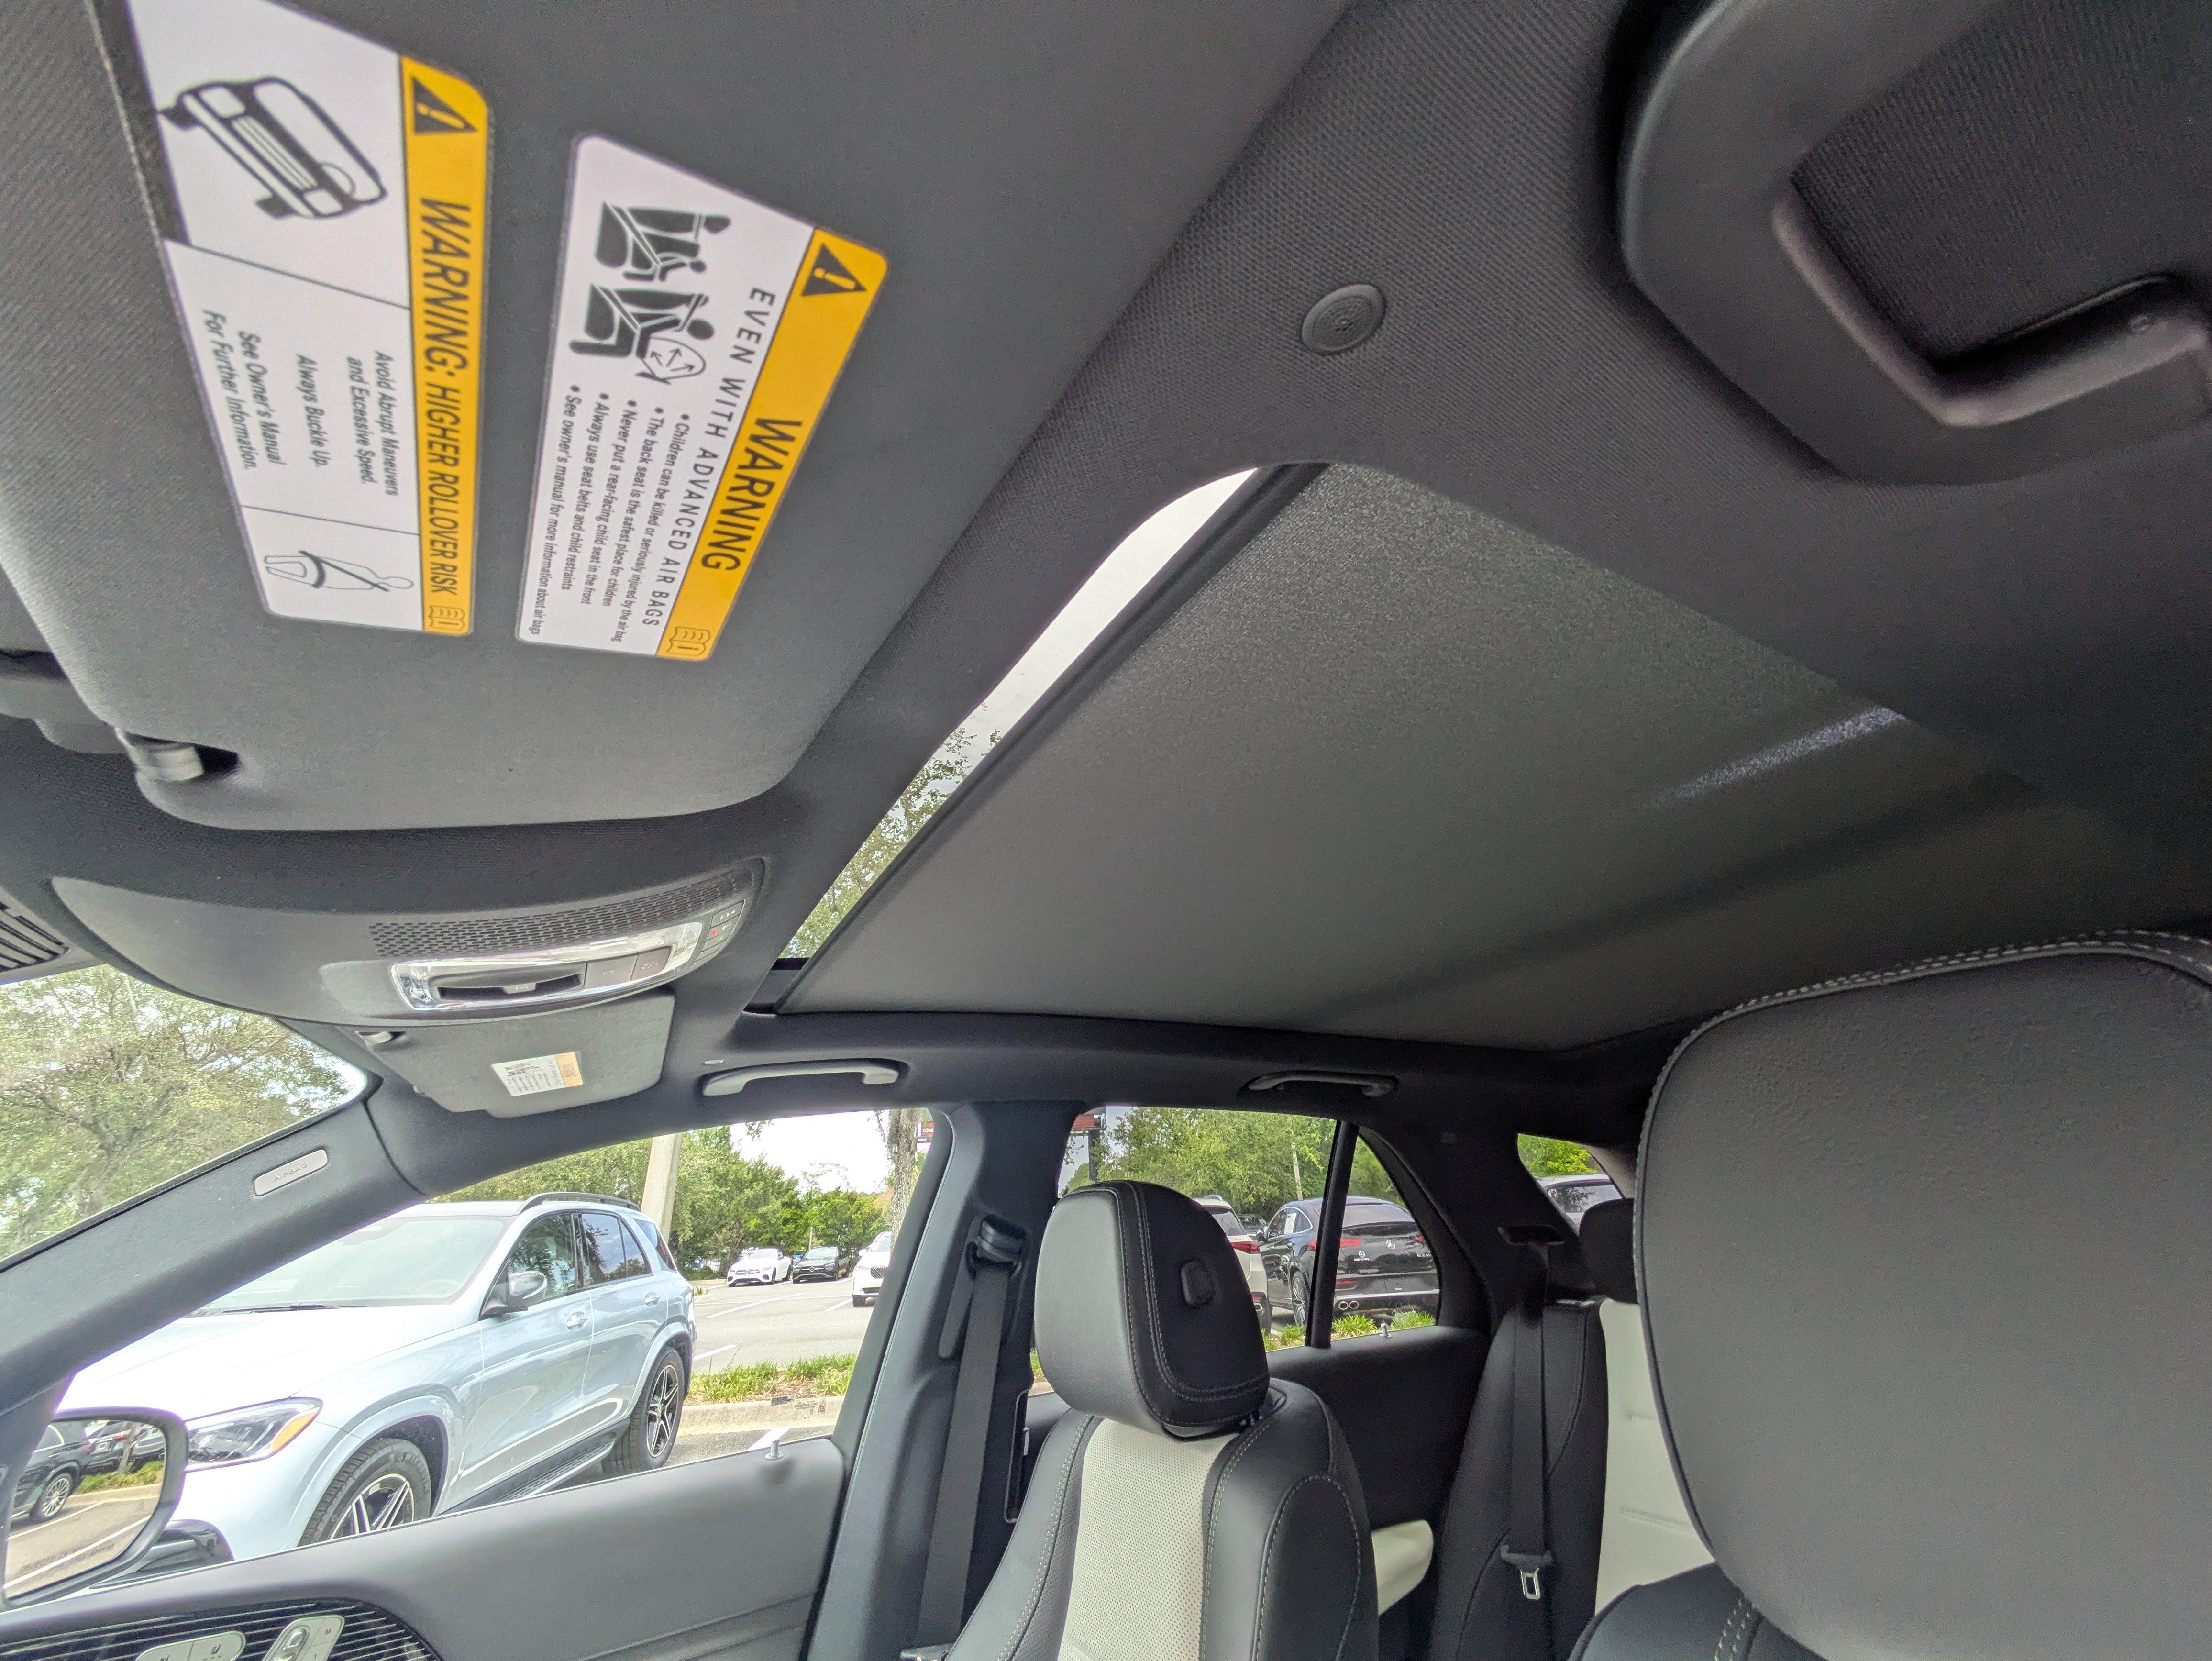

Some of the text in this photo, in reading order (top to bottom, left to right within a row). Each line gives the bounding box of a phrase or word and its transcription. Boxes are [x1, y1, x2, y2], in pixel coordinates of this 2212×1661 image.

[202, 310, 258, 469] For Further Information.
[237, 331, 286, 465] See Owner's Manual
[296, 354, 332, 467] Always Buckle Up.
[346, 356, 377, 484] and Excessive Speed.
[375, 350, 399, 496] Avoid Abrupt Maneuvers
[420, 197, 471, 595] WARNING: HIGHER ROLLOVER RISK
[611, 443, 626, 463] put
[617, 409, 638, 443] Never
[528, 394, 582, 635] See owner's manual for more information about air bags
[561, 401, 610, 590] Always use seat belts and child restraints
[595, 473, 619, 523] rear-facing
[602, 417, 665, 606] The back seat is the safest place for children
[641, 287, 776, 626] EVEN WITH ADVANCED AIR BAGS
[700, 417, 802, 571] WARNING
[580, 587, 596, 605] front
[584, 573, 598, 586] the
[587, 564, 601, 572] in
[589, 546, 602, 564] seat
[593, 524, 609, 545] child
[610, 422, 690, 642] Children can be killed or seriously injured by the air bag
